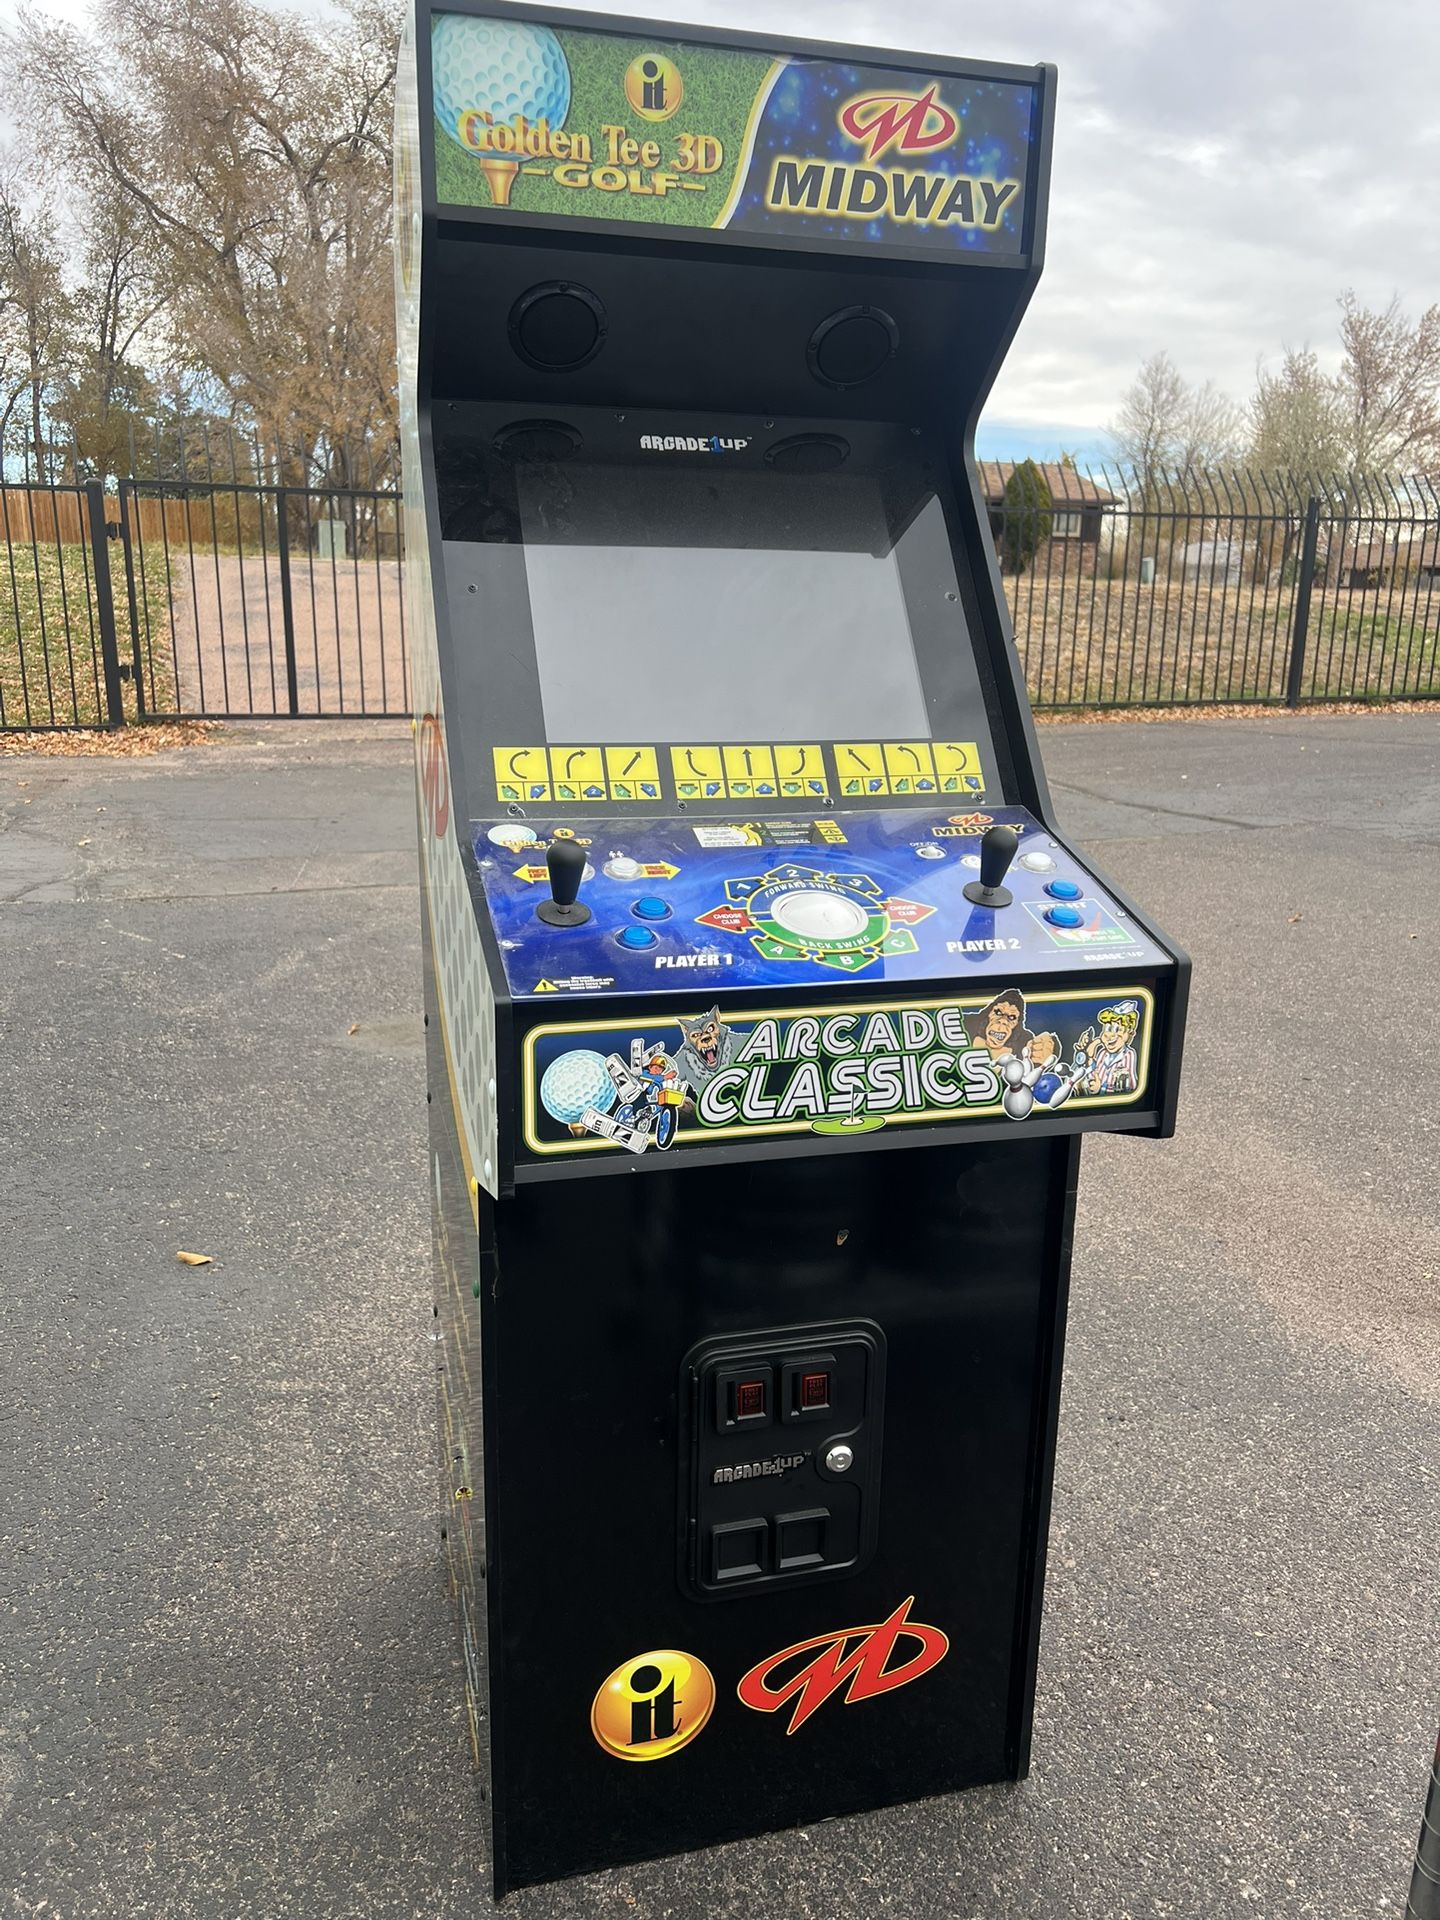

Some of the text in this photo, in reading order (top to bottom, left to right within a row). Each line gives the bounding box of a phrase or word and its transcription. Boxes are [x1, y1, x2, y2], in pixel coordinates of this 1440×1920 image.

[458, 108, 724, 174] Golden Tee 3D
[553, 163, 680, 196] GOLF
[770, 160, 1017, 225] MIDWAY
[786, 869, 800, 878] 2
[736, 882, 752, 891] 1
[764, 881, 846, 898] FORWARD SWING
[849, 878, 863, 887] 3
[713, 912, 742, 920] CHOOSE
[836, 935, 870, 949] SWING
[890, 939, 906, 948] C
[946, 937, 1021, 953] PLAYER 2
[769, 945, 784, 955] A
[655, 953, 733, 968] PLAYER 1
[840, 955, 855, 965] B
[735, 1008, 969, 1063] ARCADE
[700, 1049, 1000, 1123] CLASSICS
[626, 1664, 683, 1747] it
